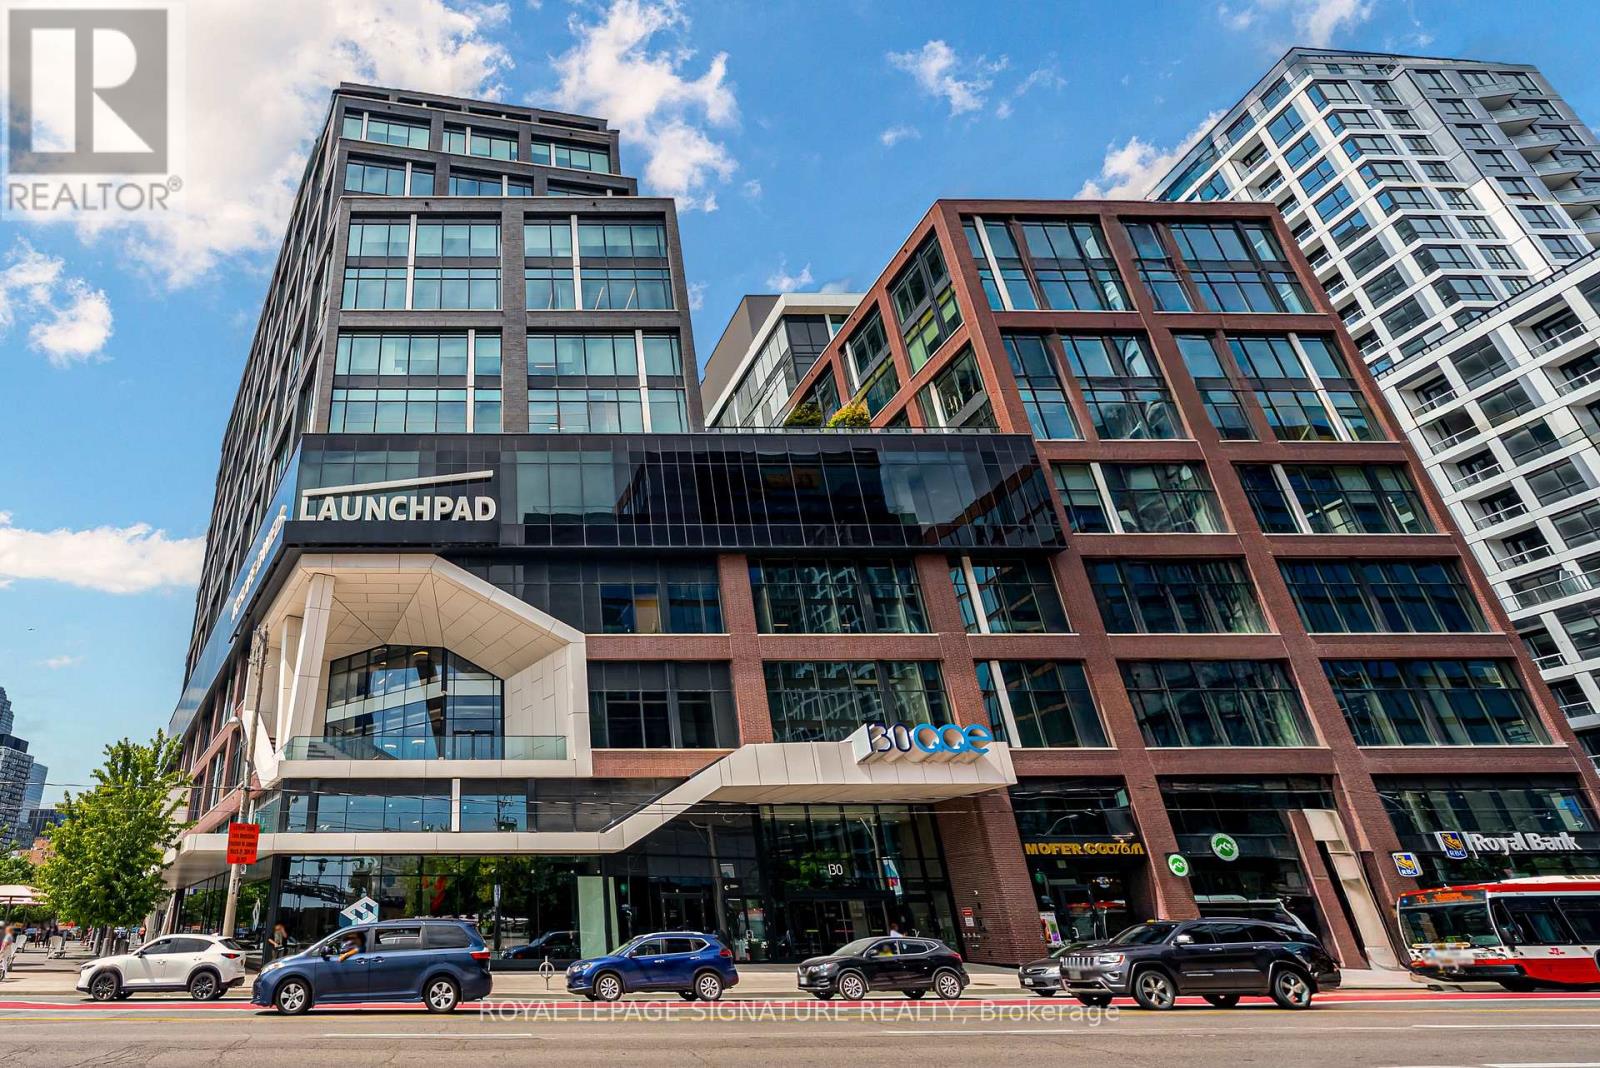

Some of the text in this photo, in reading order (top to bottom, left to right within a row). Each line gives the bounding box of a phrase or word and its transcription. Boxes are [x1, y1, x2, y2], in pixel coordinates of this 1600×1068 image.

[299, 495, 497, 521] LAUNCHPAD
[1470, 831, 1582, 855] Royal Bank
